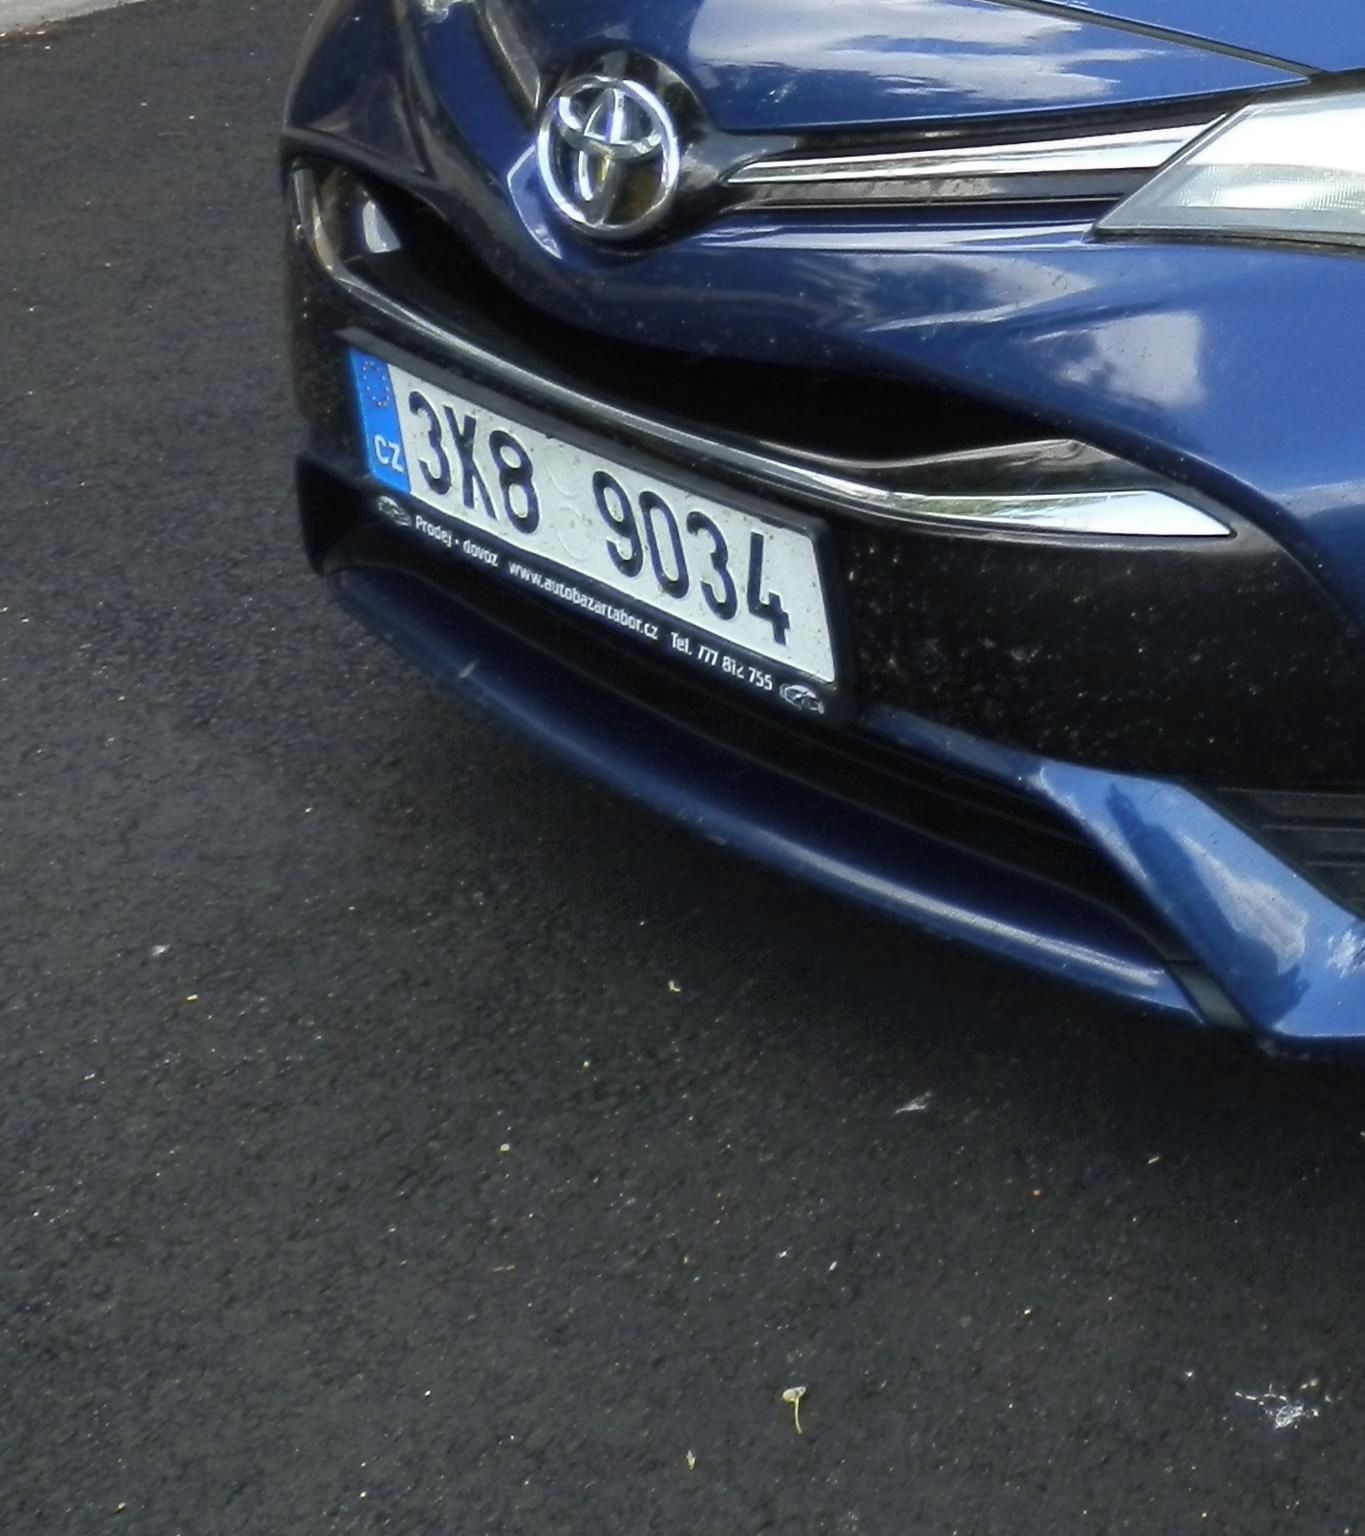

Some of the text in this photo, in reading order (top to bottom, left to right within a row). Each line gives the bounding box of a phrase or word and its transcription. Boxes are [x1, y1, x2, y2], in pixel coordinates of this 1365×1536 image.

[375, 390, 790, 646] CZ 3X8 9034
[415, 514, 452, 548] Prodej
[463, 539, 498, 568] dovoz
[508, 561, 659, 641] www.autobazartabor.cz
[670, 631, 692, 656] Tel.
[748, 666, 773, 691] 755
